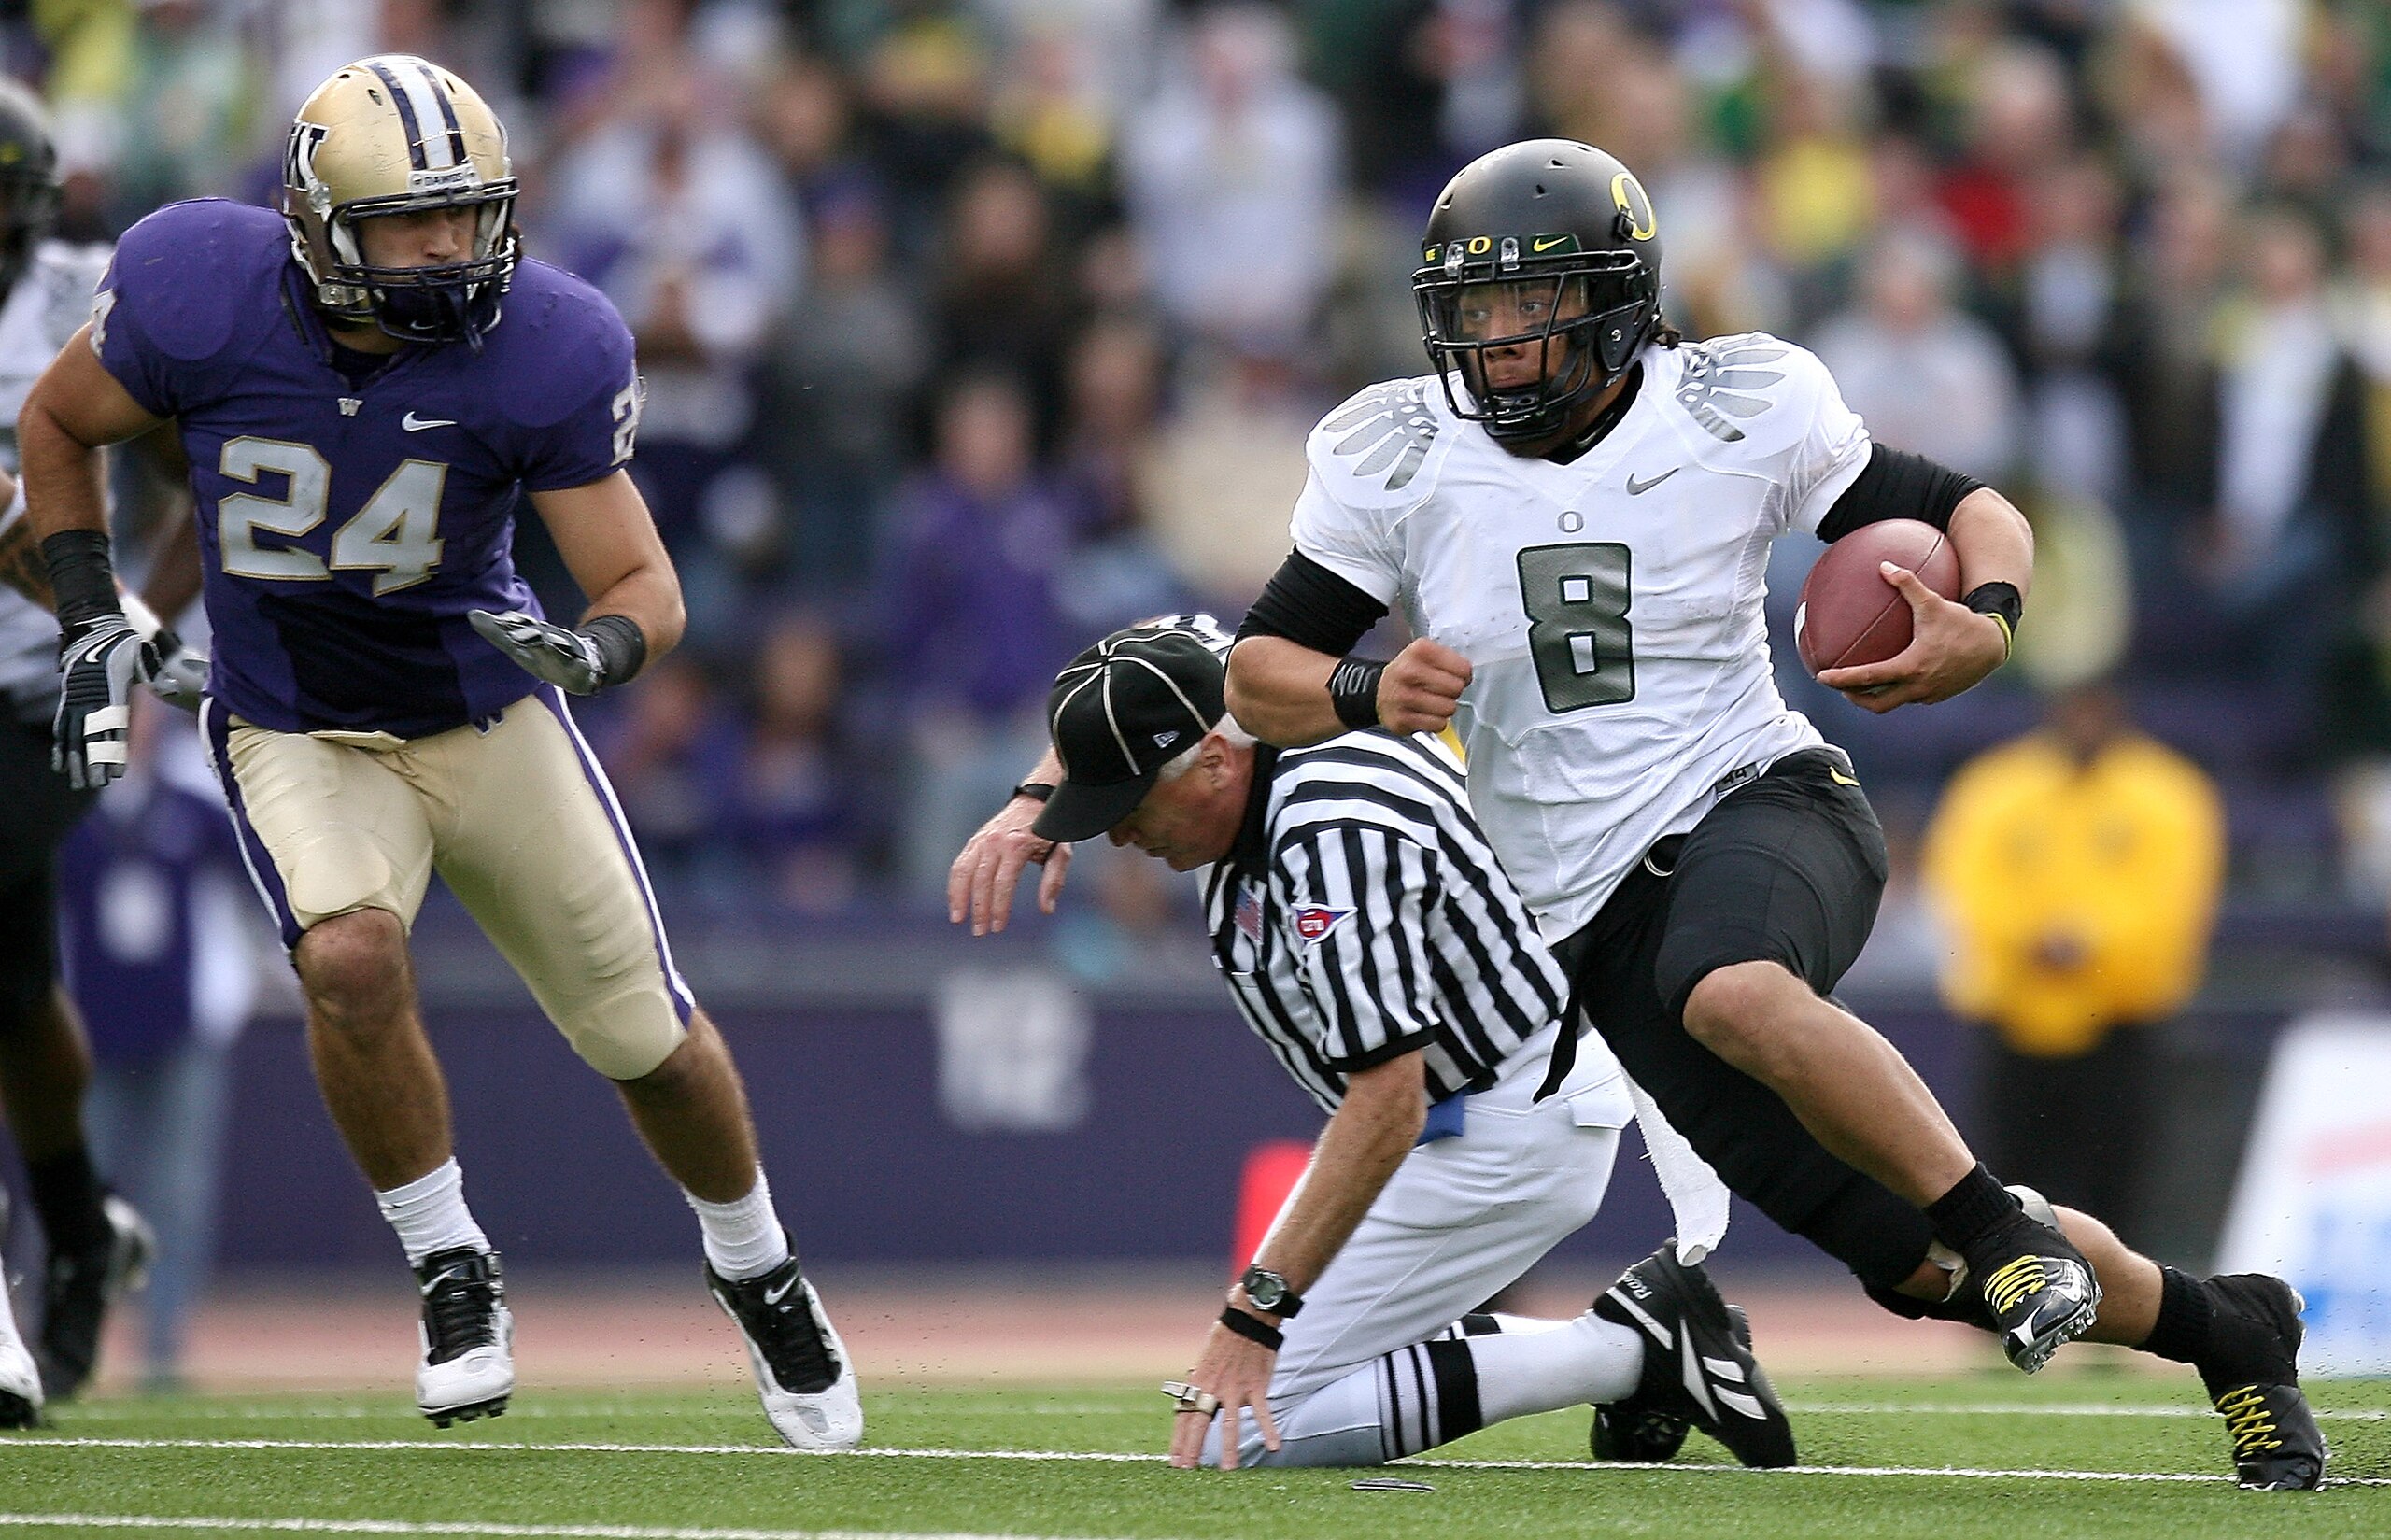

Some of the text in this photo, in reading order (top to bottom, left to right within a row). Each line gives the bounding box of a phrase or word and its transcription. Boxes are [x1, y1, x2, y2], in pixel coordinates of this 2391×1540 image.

[1610, 172, 1657, 241] O
[1466, 236, 1493, 255] O
[337, 397, 364, 417] W
[218, 435, 450, 598] 24
[1557, 511, 1584, 533] O
[1516, 542, 1636, 715] 8
